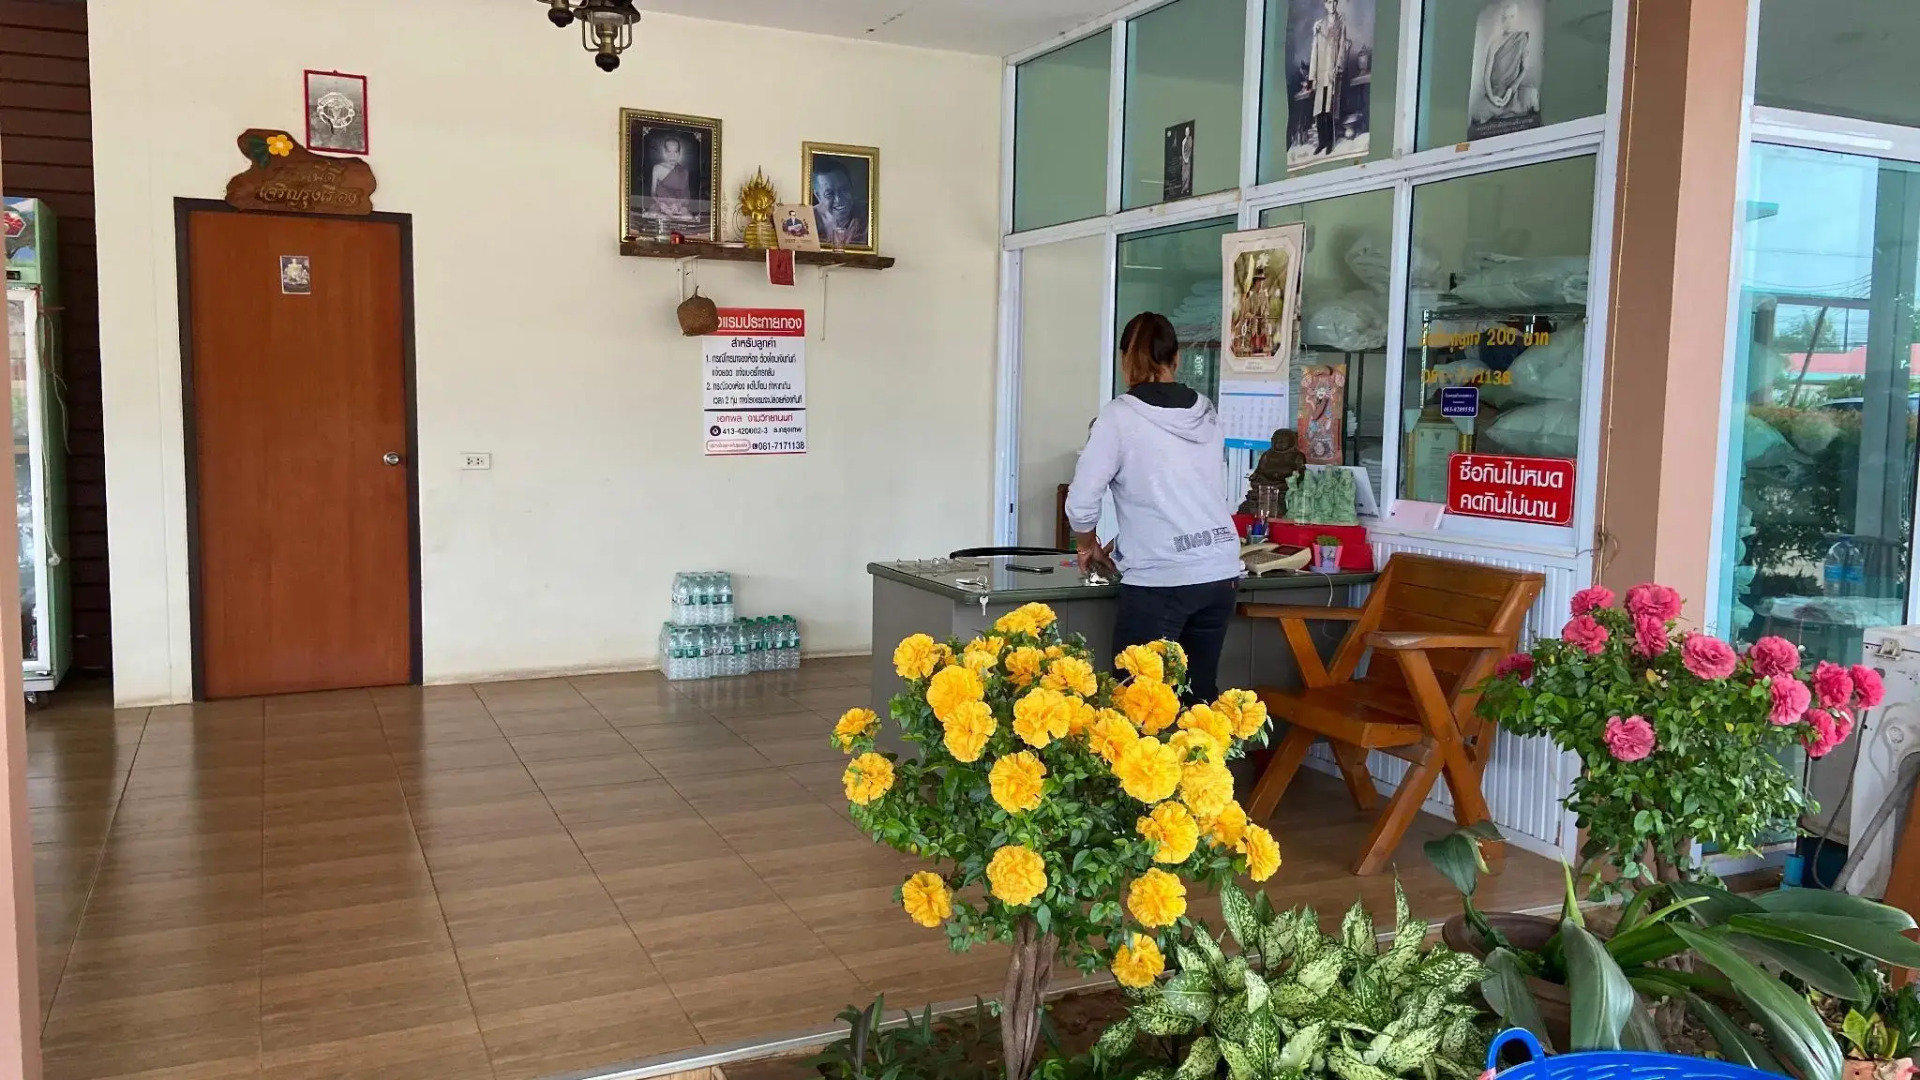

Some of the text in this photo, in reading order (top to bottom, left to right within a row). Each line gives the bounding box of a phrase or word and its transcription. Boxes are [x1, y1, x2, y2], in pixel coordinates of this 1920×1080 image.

[717, 313, 802, 329] งแรมประกายทอง
[731, 337, 776, 350] สำหรับลูกค้า
[1487, 327, 1516, 346] 200
[1523, 331, 1549, 346] บาท
[1460, 490, 1557, 519] คดกินไม่นาน
